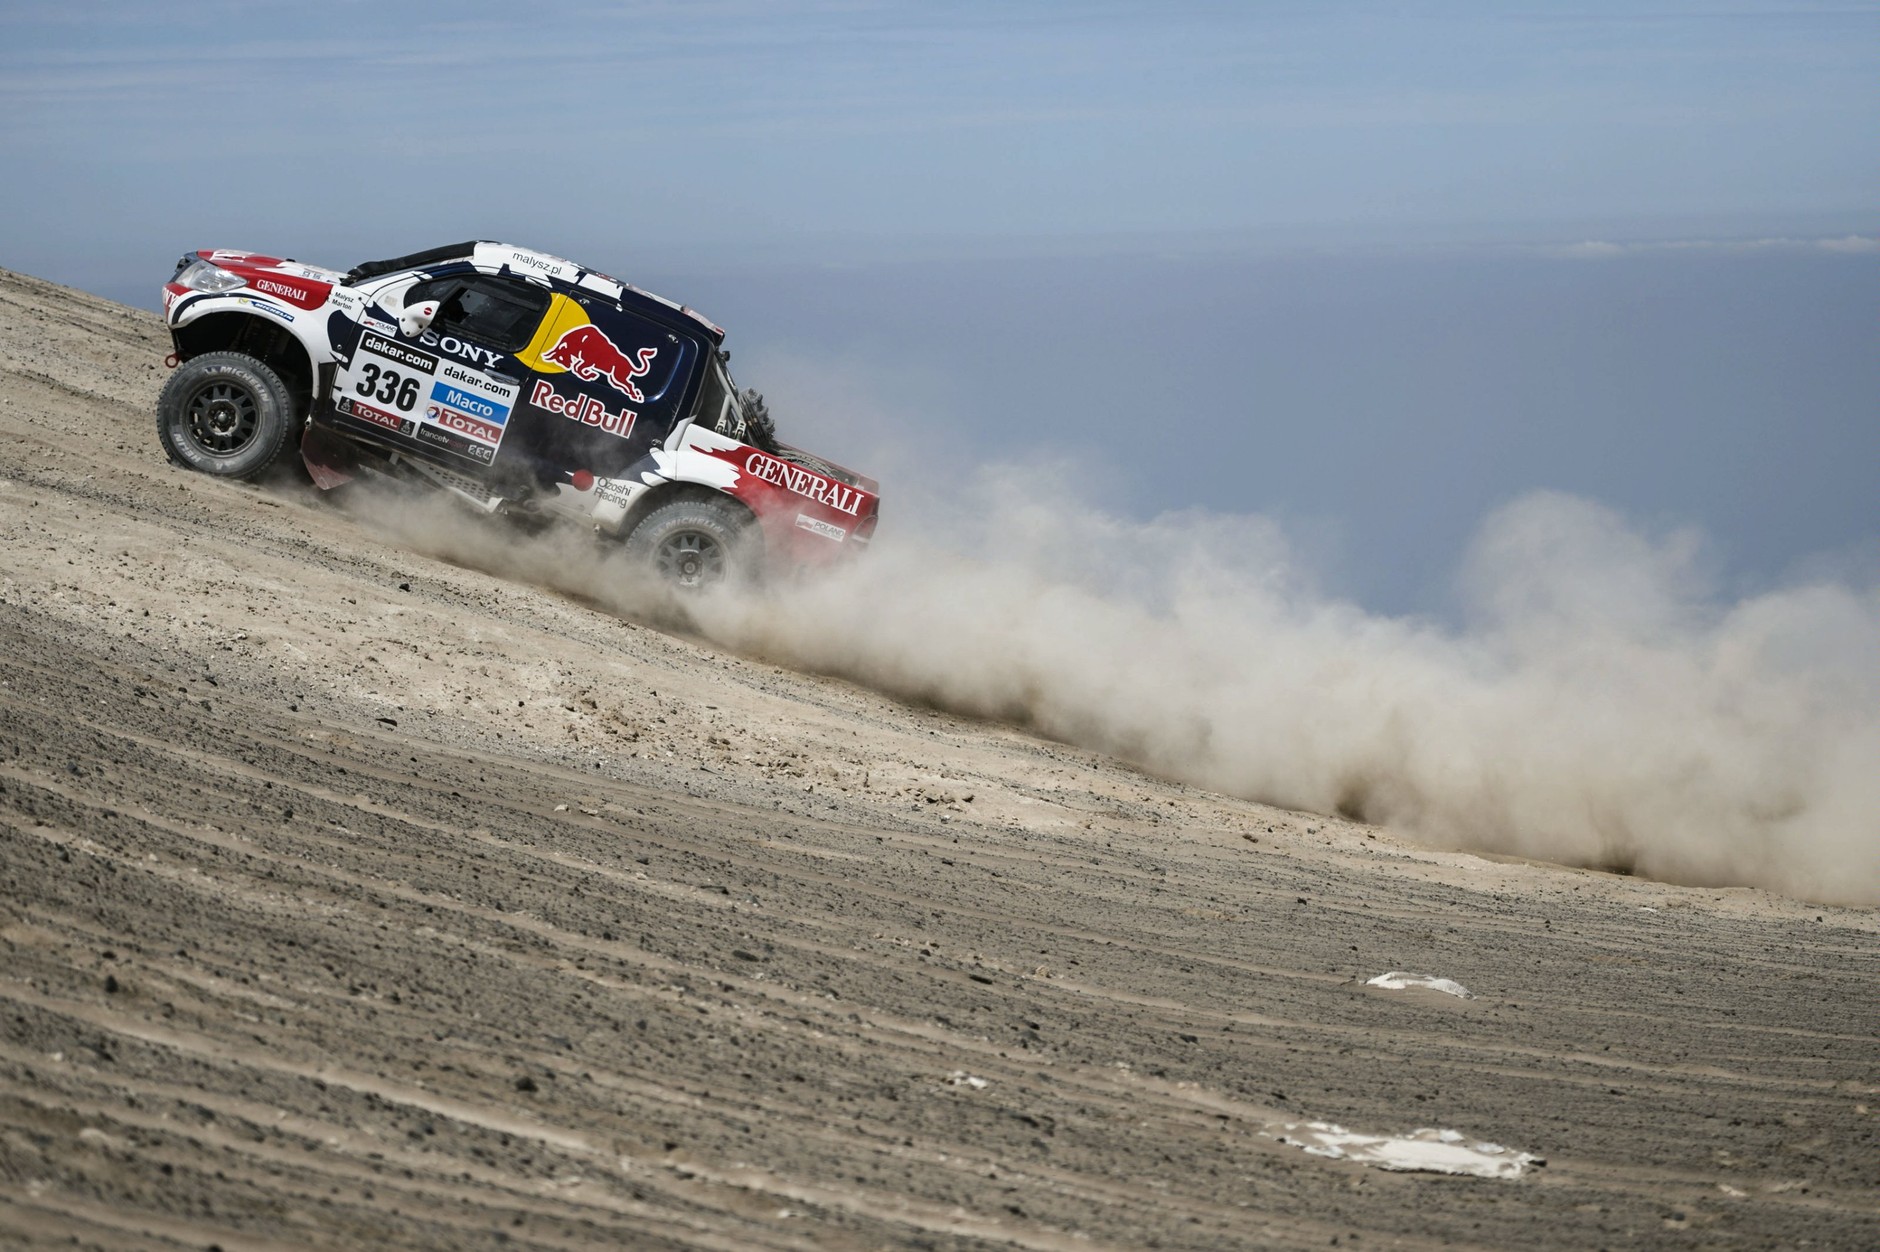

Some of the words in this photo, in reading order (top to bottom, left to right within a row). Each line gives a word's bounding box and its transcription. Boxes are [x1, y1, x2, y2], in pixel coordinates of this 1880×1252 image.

[512, 251, 562, 276] malysz.pl
[256, 278, 308, 302] GENERALI
[254, 302, 294, 321] MICHELIN
[331, 298, 353, 311] Marton
[376, 321, 397, 333] POLAND
[365, 336, 434, 371] dakar.com
[419, 328, 505, 369] SONY
[219, 366, 271, 403] MICHELIN
[355, 362, 421, 413] 336
[444, 366, 512, 398] dakar.com
[356, 403, 398, 428] TOTAL
[446, 390, 494, 417] Macro
[443, 410, 498, 442] TOTAL
[598, 475, 633, 497] Ozoshi
[745, 453, 864, 516] GENERALI
[593, 487, 628, 509] Racing
[665, 516, 725, 534] MICHELIN
[814, 521, 845, 537] POLAND
